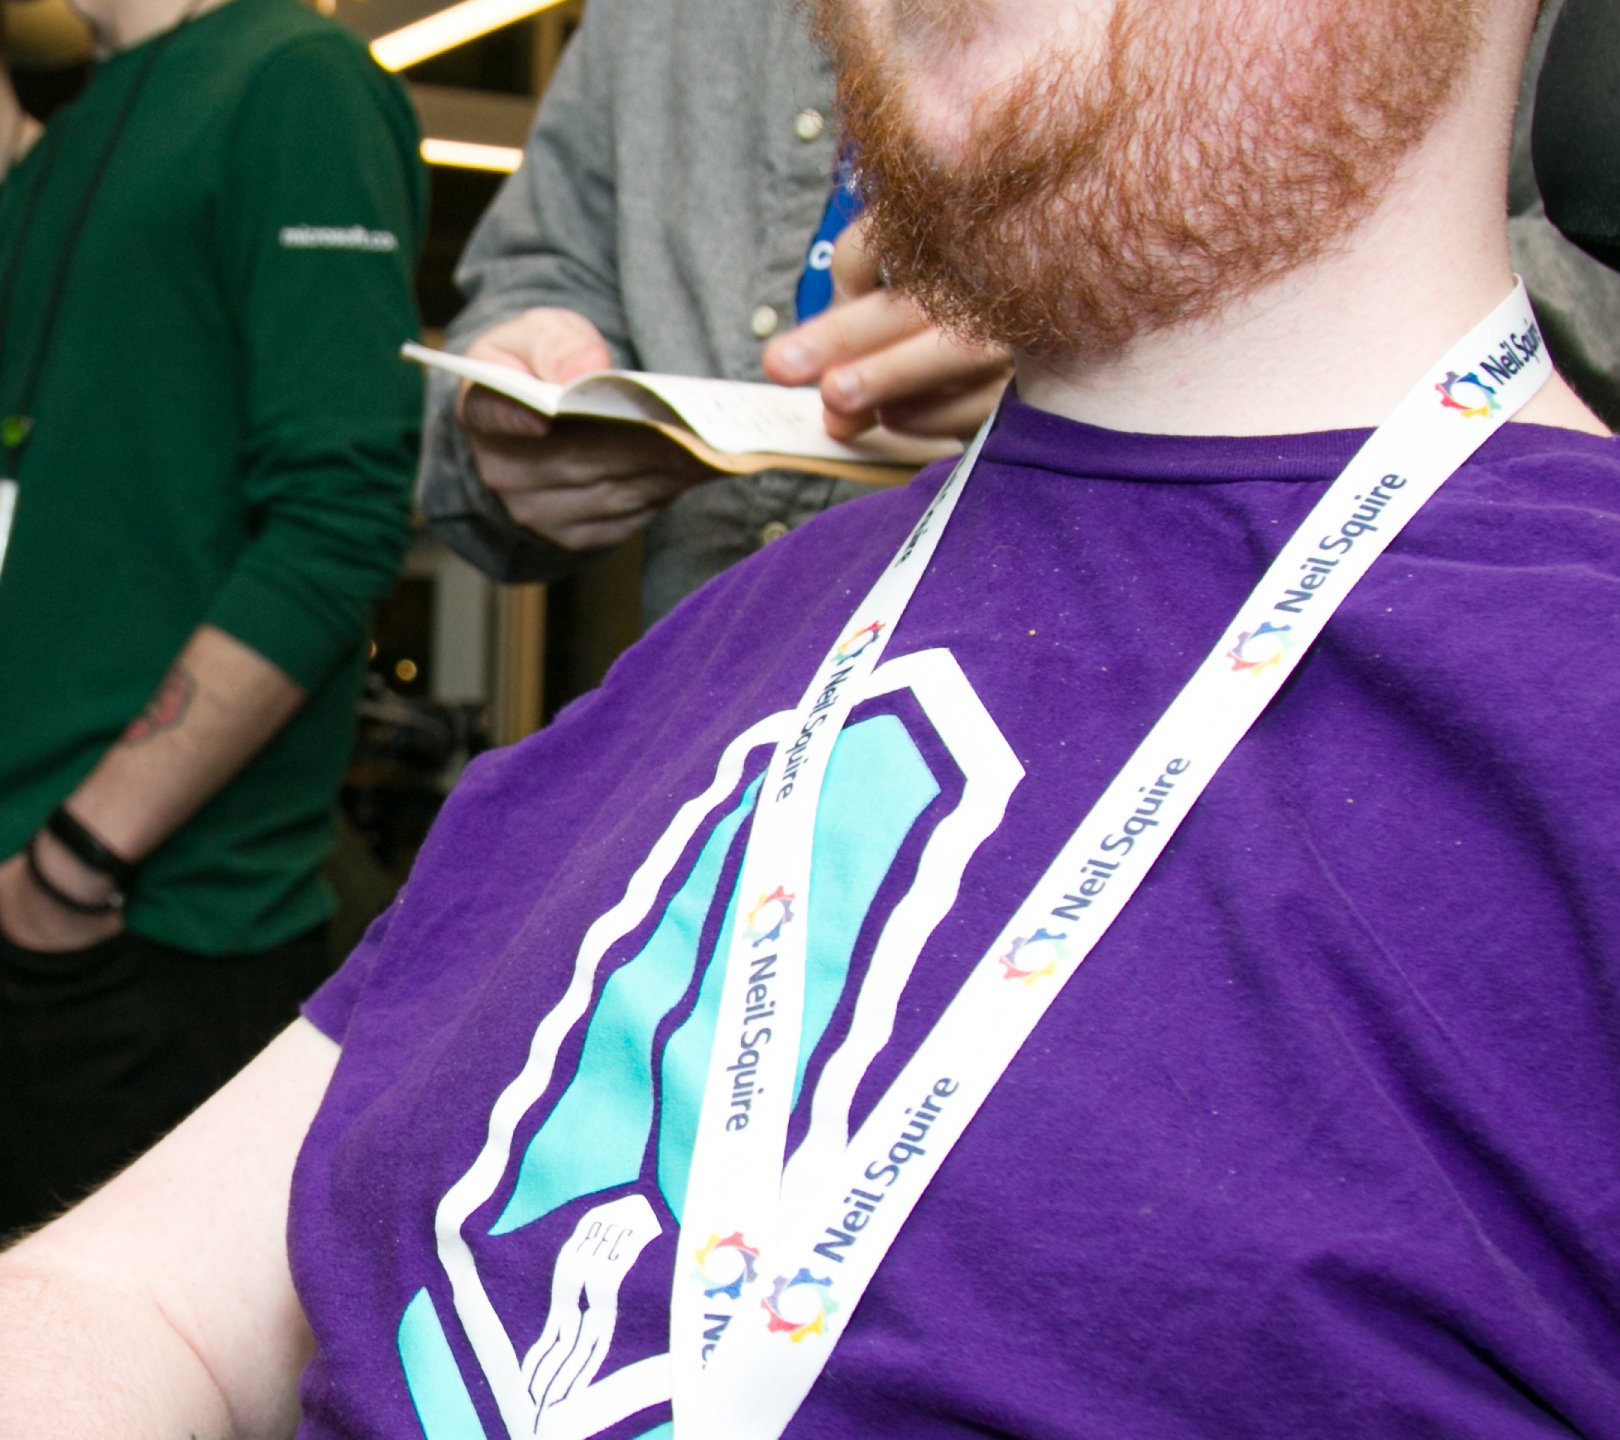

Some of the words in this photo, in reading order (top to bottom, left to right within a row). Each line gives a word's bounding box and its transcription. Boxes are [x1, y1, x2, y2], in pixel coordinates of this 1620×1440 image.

[1480, 339, 1524, 385] Neil
[1273, 557, 1340, 613] Neil
[1319, 473, 1408, 554] Squire
[808, 665, 854, 717] Neil
[776, 714, 828, 802] Squire
[1051, 859, 1120, 921] Neil
[1100, 757, 1191, 856] Squire
[743, 953, 778, 1026] Neil
[726, 1027, 772, 1132] Squire
[813, 1188, 885, 1263] Neil
[864, 1077, 960, 1187] Squire
